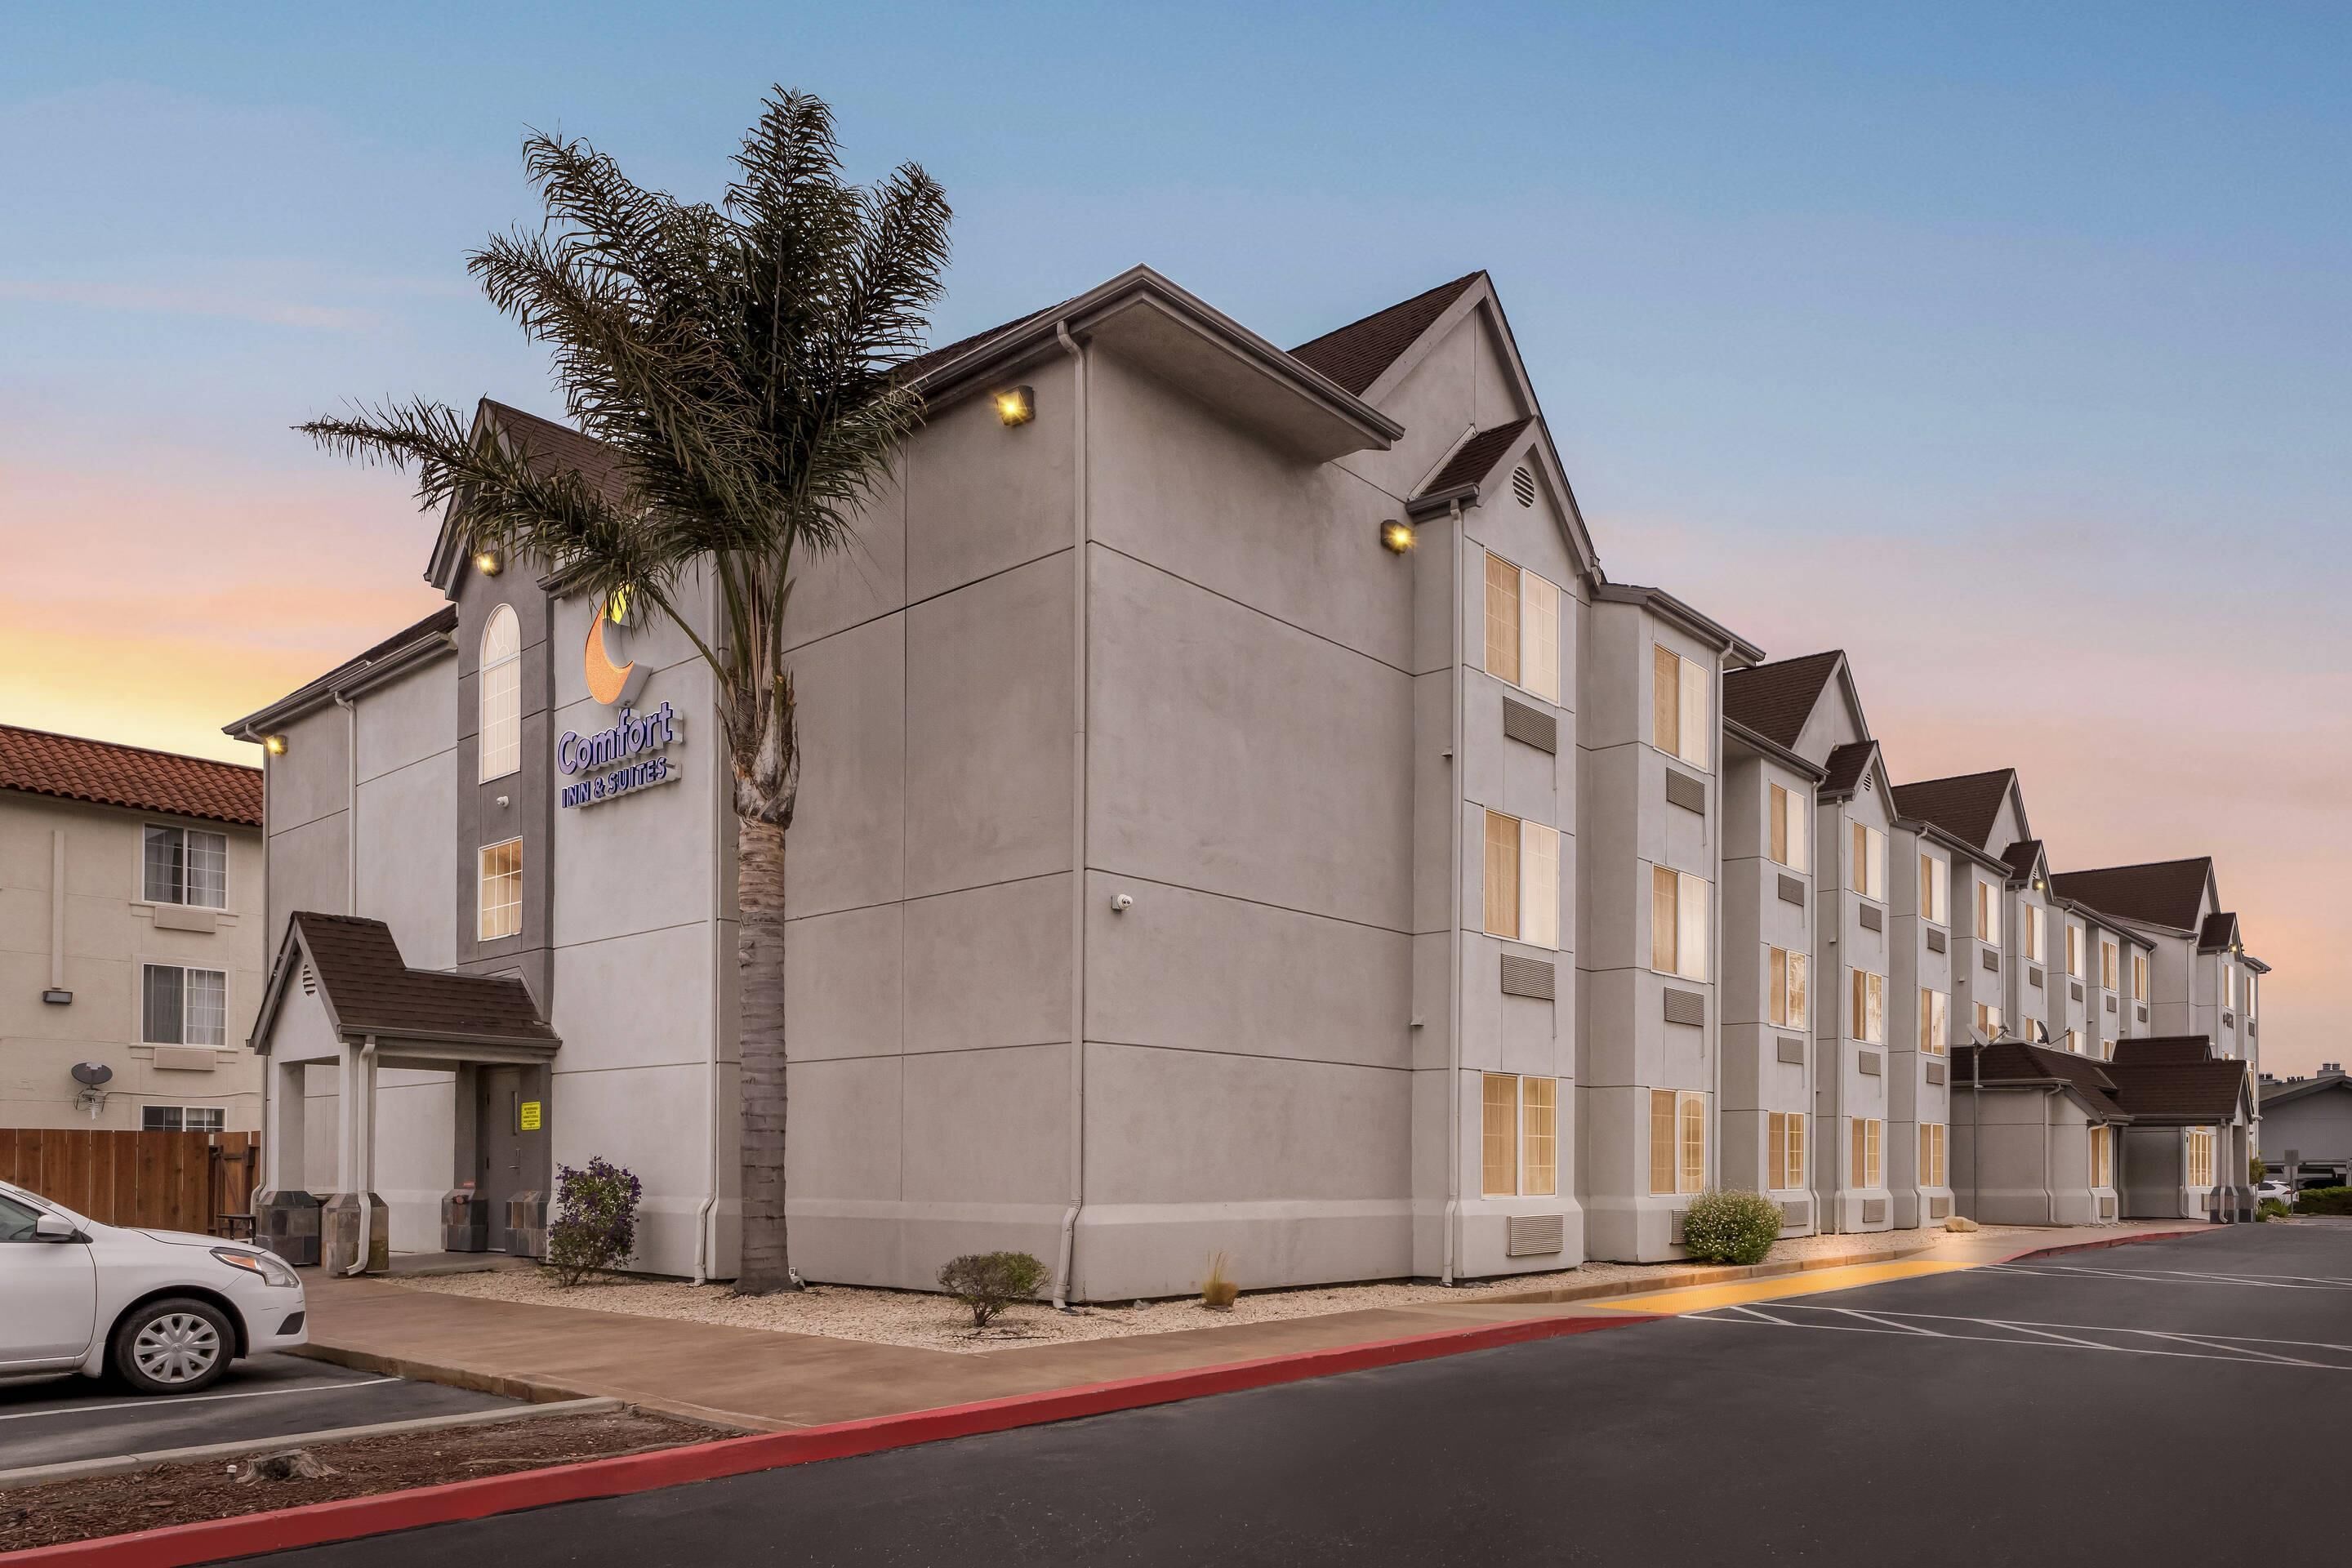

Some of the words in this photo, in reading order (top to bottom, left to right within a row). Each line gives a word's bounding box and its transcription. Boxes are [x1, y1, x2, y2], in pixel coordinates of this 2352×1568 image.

[557, 701, 674, 775] Comfort
[561, 781, 591, 808] INN
[594, 777, 606, 798] &
[608, 756, 667, 795] SUITES
